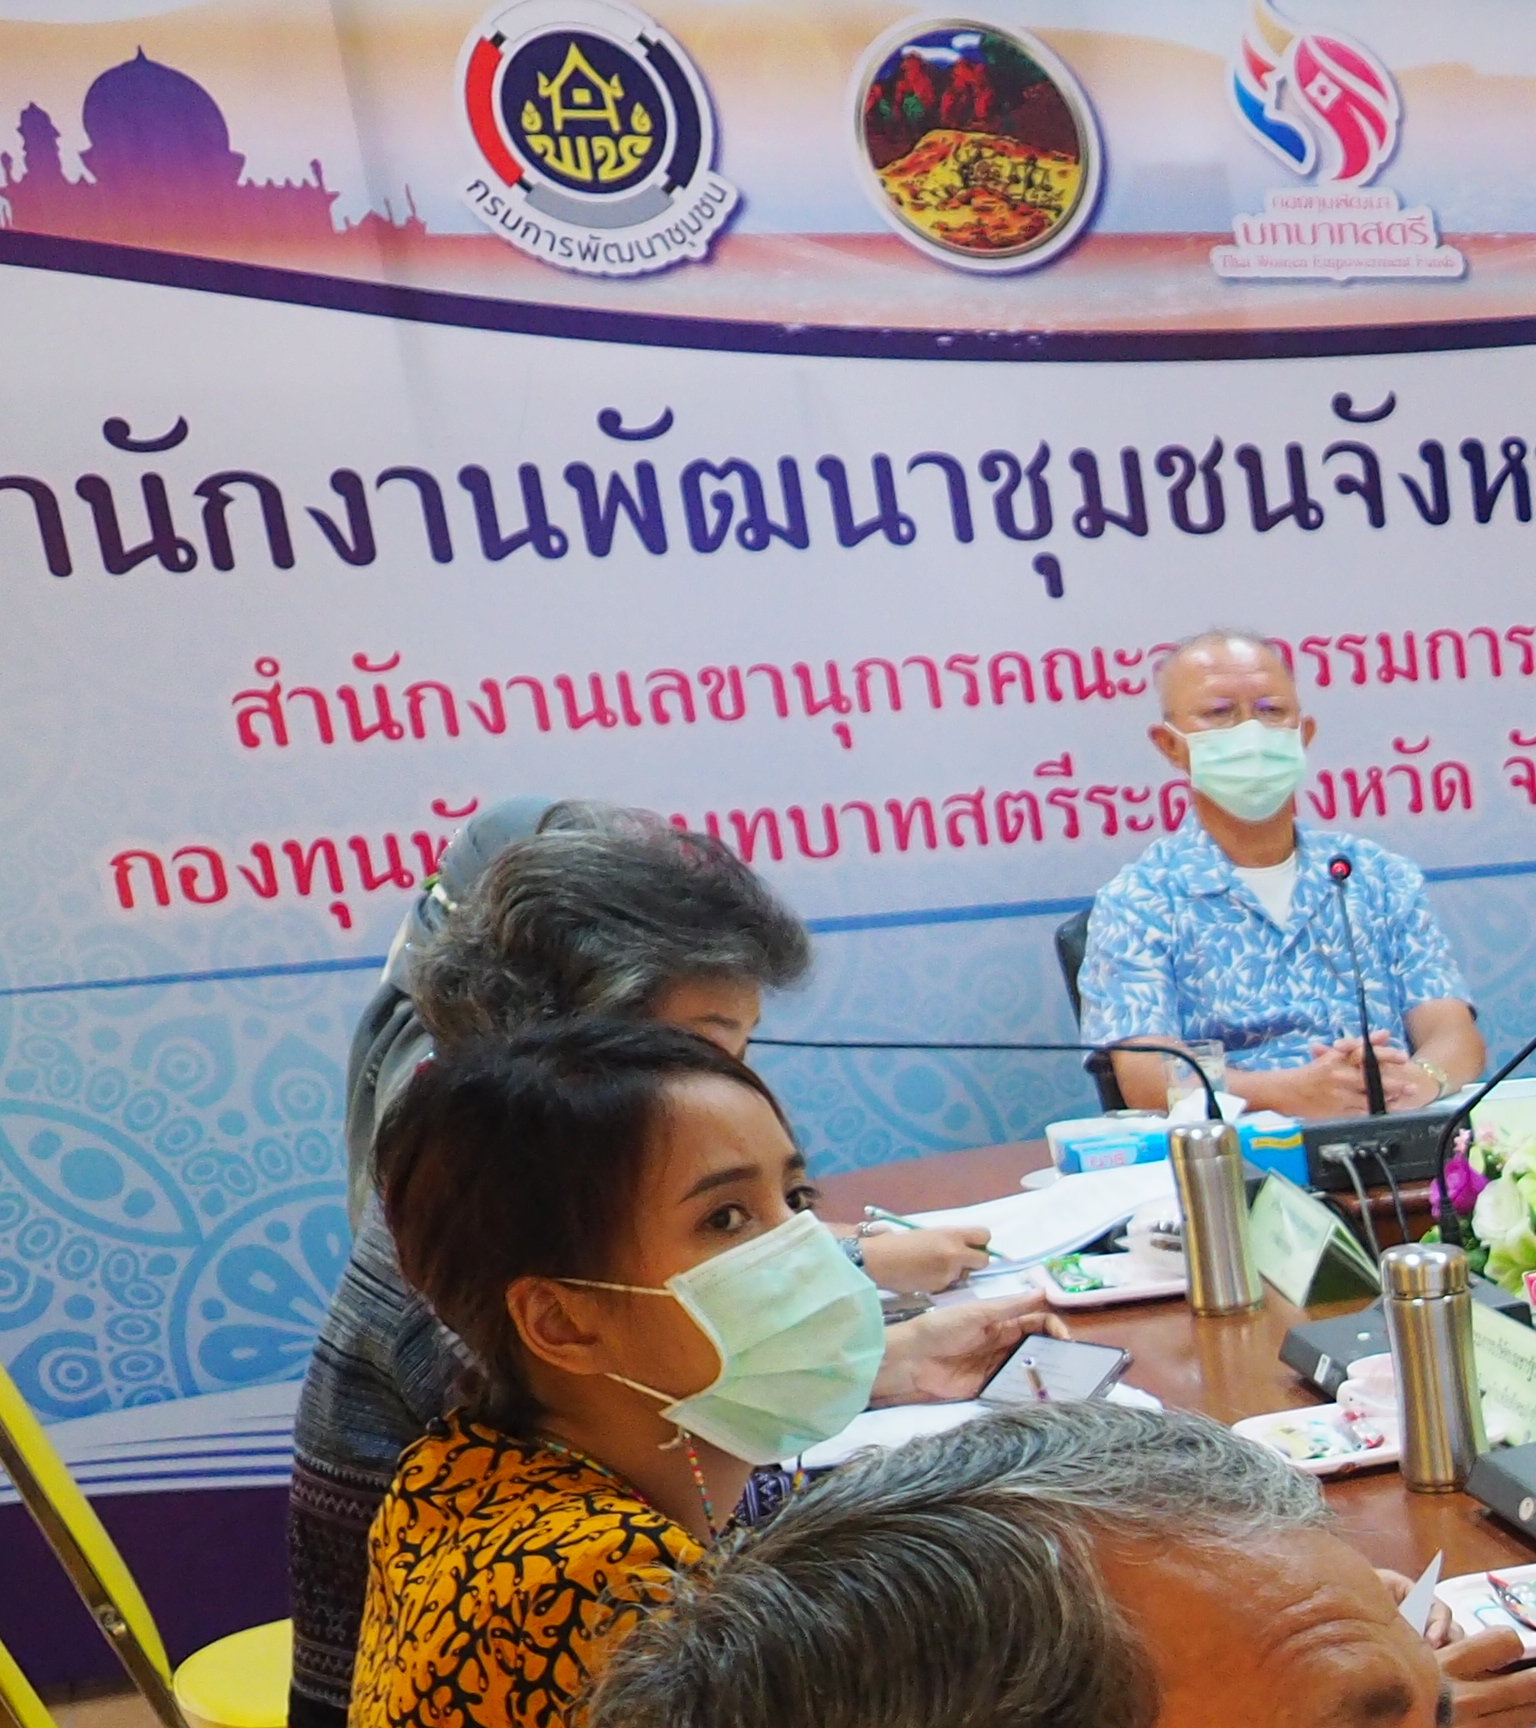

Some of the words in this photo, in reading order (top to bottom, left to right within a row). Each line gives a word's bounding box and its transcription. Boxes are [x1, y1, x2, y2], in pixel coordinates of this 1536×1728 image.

[466, 178, 728, 265] กรมการพัฒนาชุมชน
[1241, 215, 1430, 247] บทบาทสตรี
